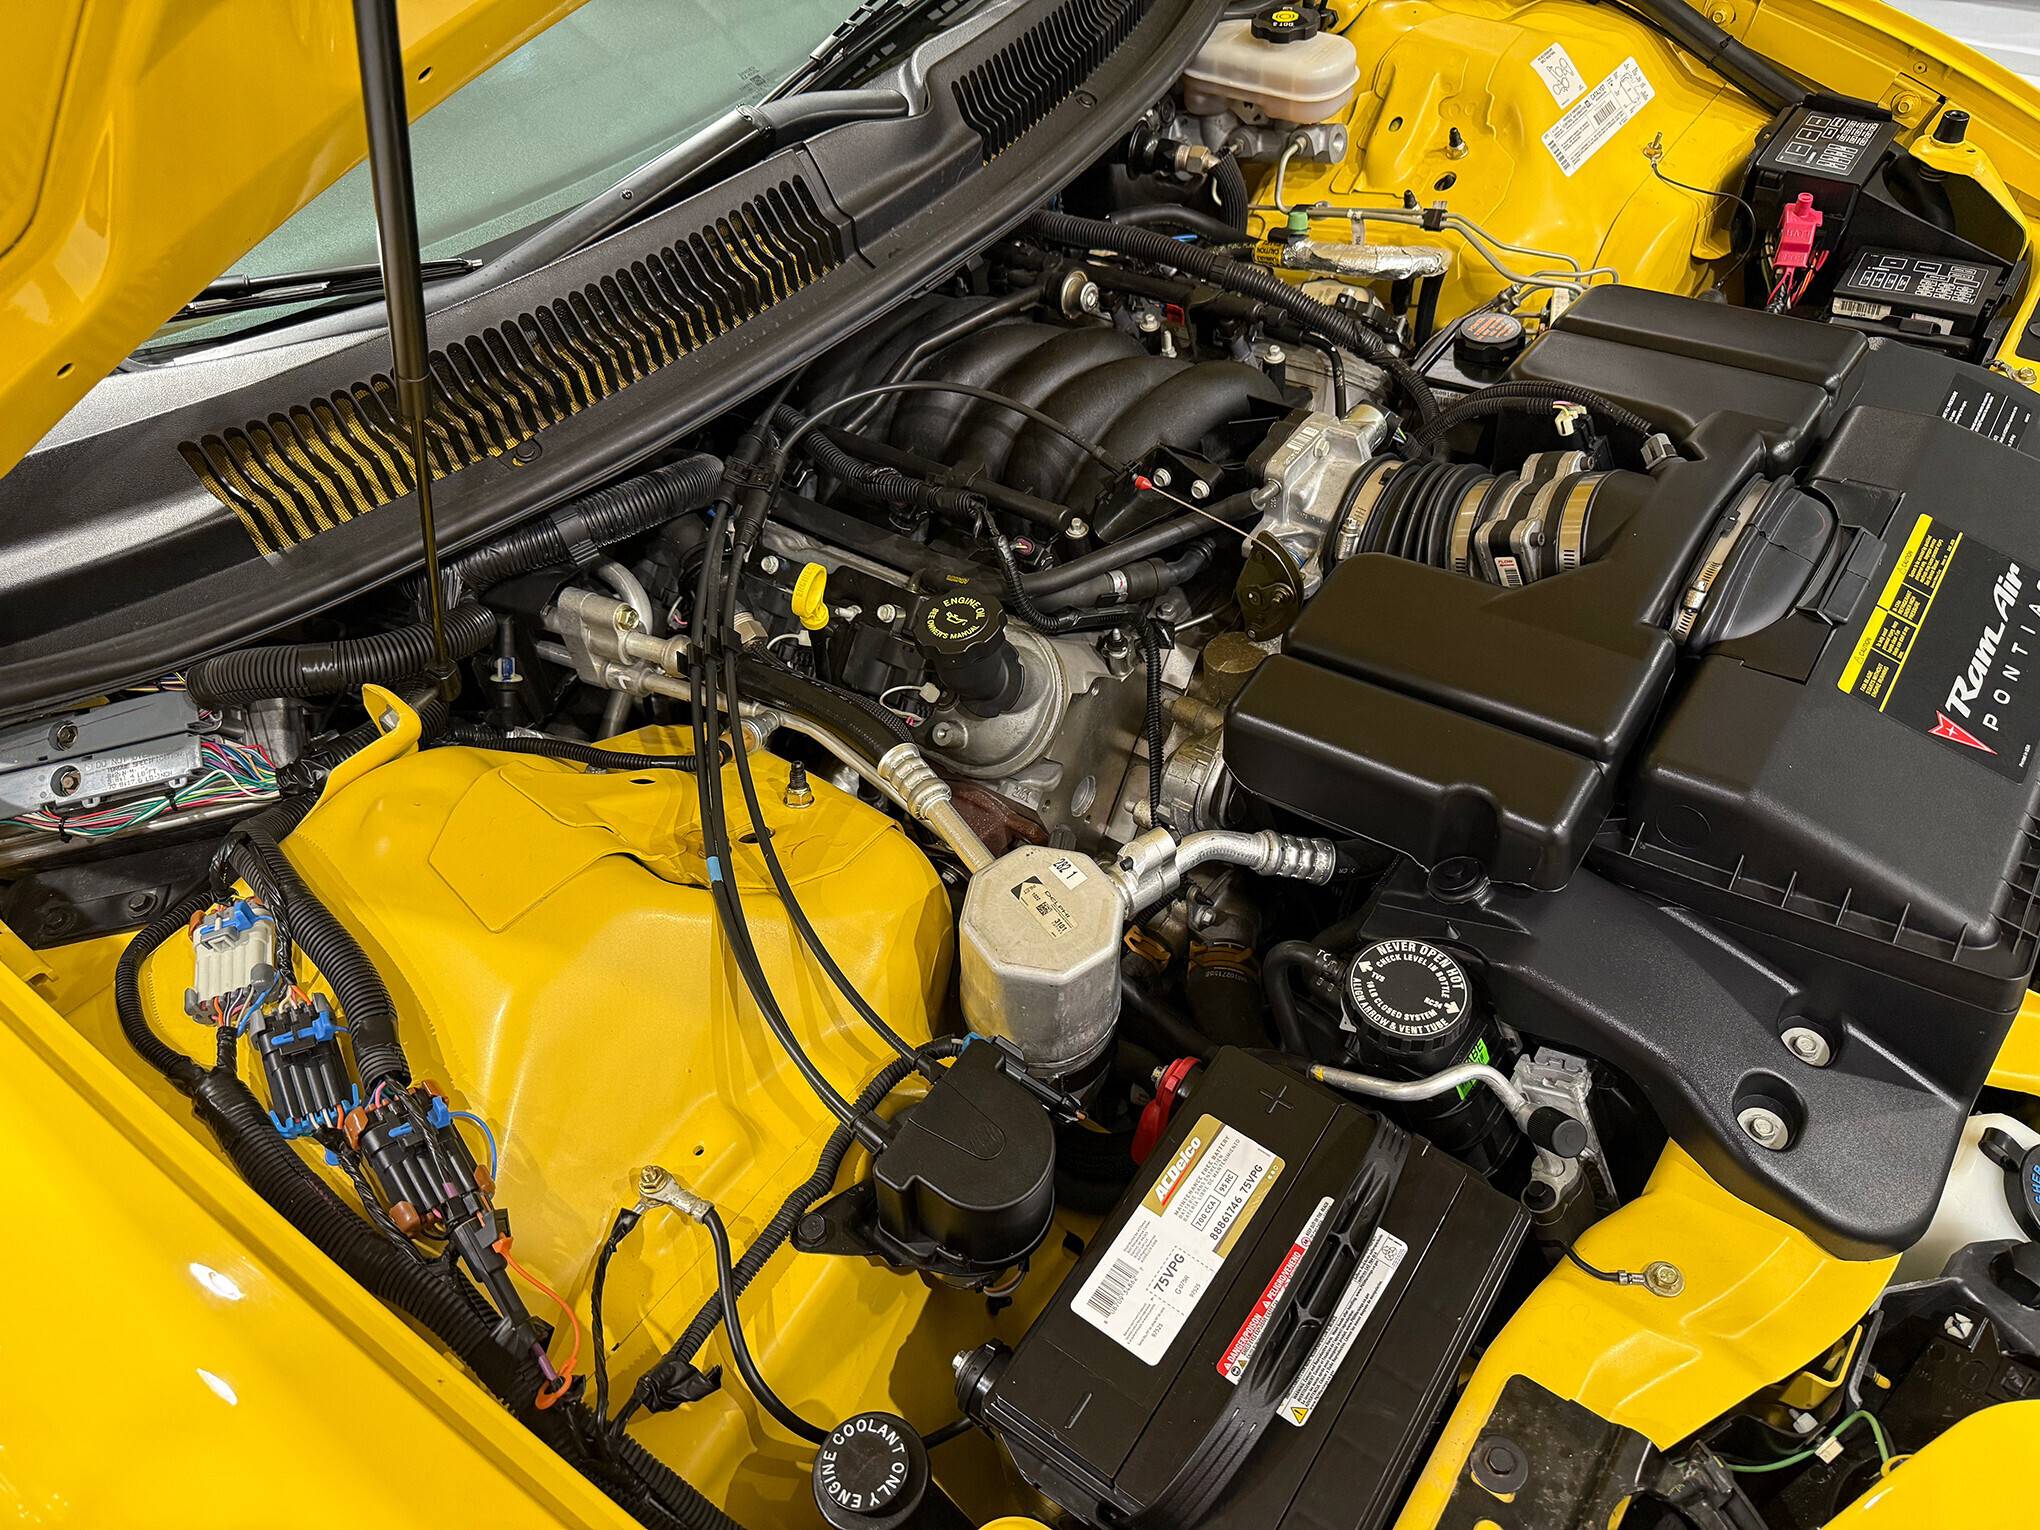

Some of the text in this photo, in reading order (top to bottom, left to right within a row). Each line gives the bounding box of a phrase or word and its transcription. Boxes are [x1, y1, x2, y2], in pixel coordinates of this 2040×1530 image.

[943, 596, 986, 620] ENGINE OIL
[949, 625, 980, 640] MANUAL
[1944, 562, 2023, 719] Ram Air
[1982, 579, 2040, 732] PONTIA
[1053, 857, 1077, 879] 282 1
[1044, 890, 1070, 918] DELPHI
[1375, 953, 1451, 999] CHECK LEVEL IN BOTTLE
[1376, 942, 1465, 990] NEVER OPEN HOT
[1352, 977, 1449, 1035] ALIGN ARROW & VENT TUBE
[1373, 998, 1402, 1019] CLOSED
[1403, 1008, 1438, 1021] SYSTEM
[1151, 1135, 1203, 1202] ACDelco
[1173, 1135, 1230, 1216] MAINTENANCE FREE BATTERY
[1218, 1173, 1234, 1192] 95 RC
[1195, 1199, 1216, 1227] 700 CCA
[1209, 1163, 1263, 1240] 88861746 75VPG
[1153, 1252, 1186, 1294] 75VPG
[1226, 1312, 1262, 1362] DANGER/POISON
[1266, 1250, 1301, 1300] PELIGRO/VENENO
[822, 1418, 906, 1509] ENGINE COOLANT ONLY
